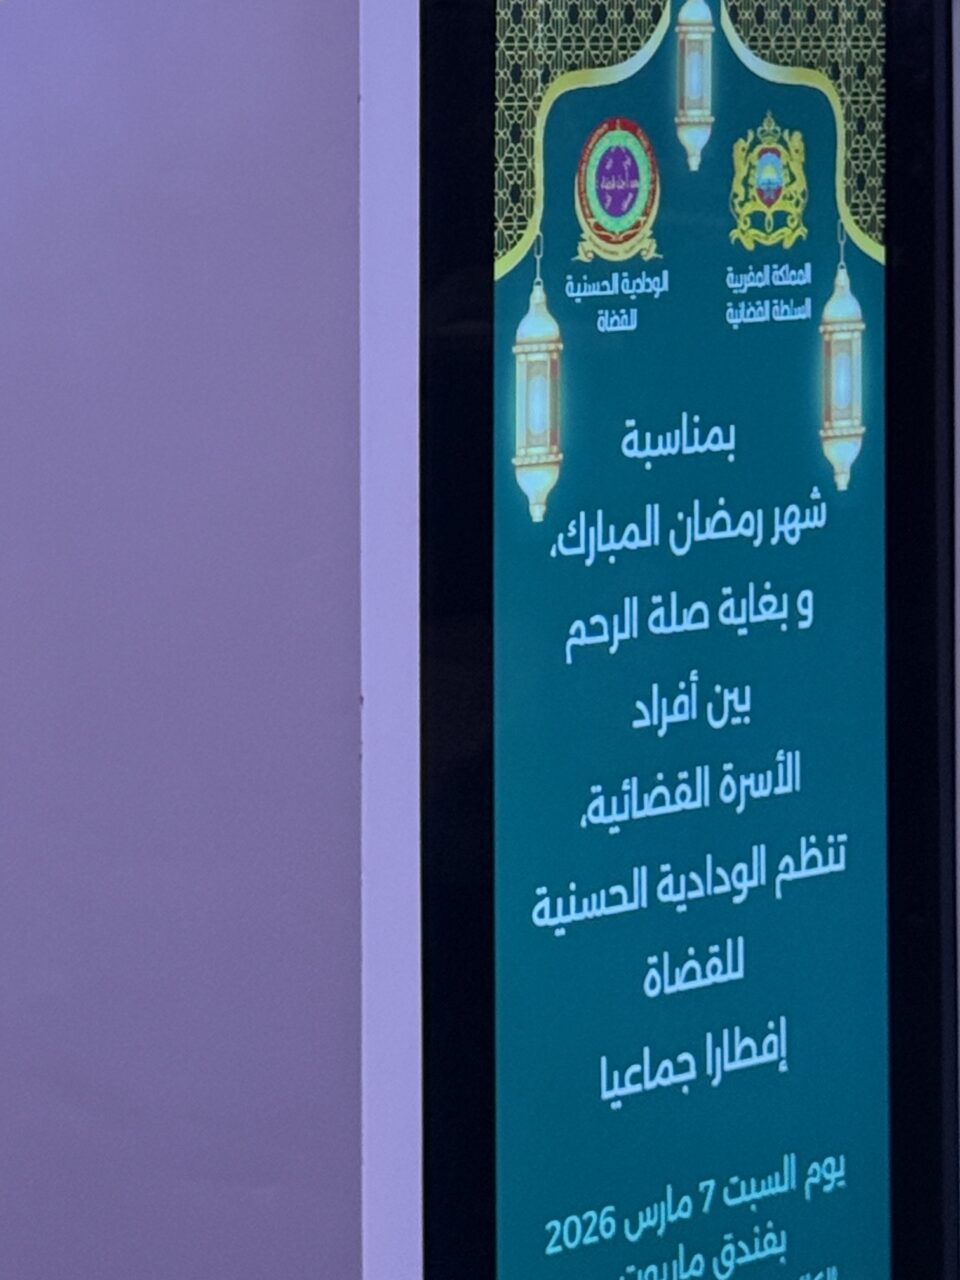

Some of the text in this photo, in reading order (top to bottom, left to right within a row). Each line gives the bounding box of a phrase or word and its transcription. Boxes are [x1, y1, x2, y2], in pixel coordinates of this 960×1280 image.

[565, 269, 669, 303] الودادية الحسنية
[621, 411, 736, 471] بمناسبة
[550, 486, 827, 567] شهر رمضان المبارك،
[565, 581, 815, 665] و بغاية صلة الرحم
[632, 669, 751, 738] بين أفراد
[719, 749, 801, 814] الأسرة
[531, 833, 848, 937] تنظم الودادية الحسنية
[643, 935, 745, 998] للقضاة
[600, 1015, 788, 1110] إفطارا جماعيا
[544, 1152, 847, 1256] يوم السبت 7 مارس 2026
[712, 1220, 788, 1279] بفندق
